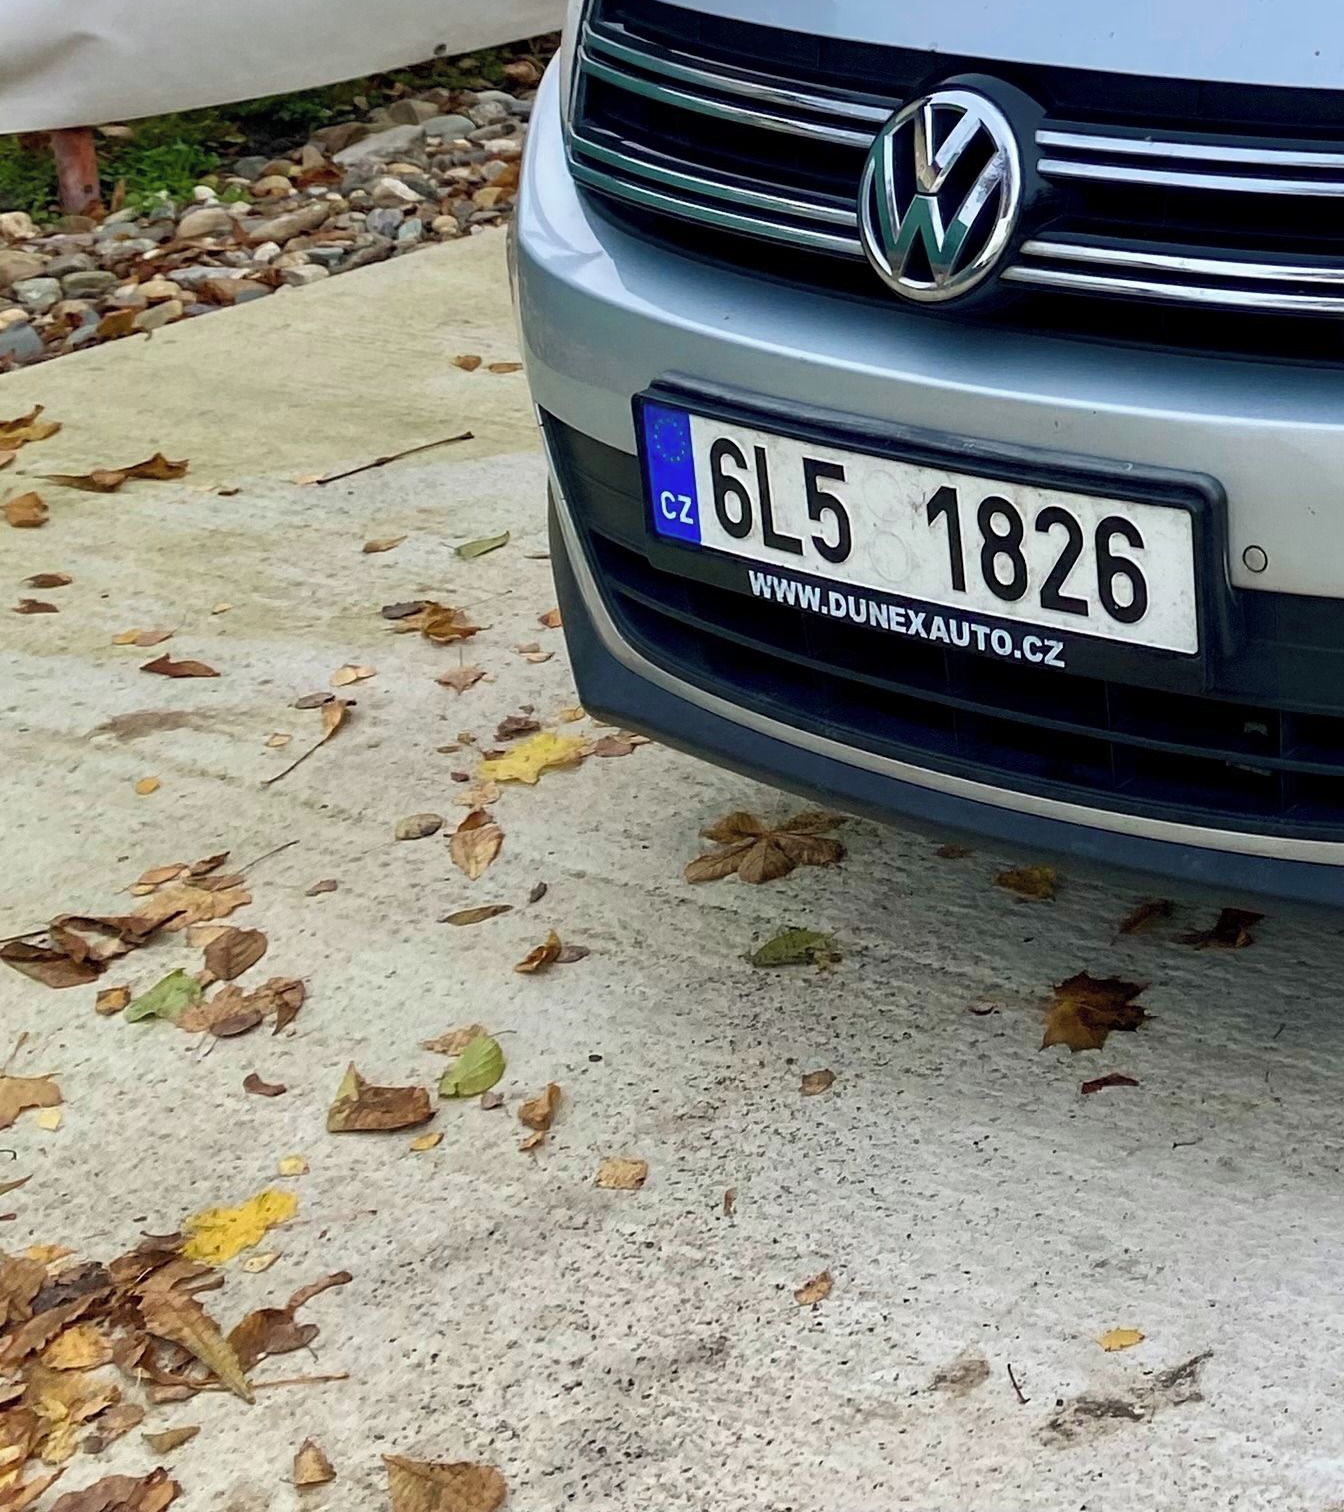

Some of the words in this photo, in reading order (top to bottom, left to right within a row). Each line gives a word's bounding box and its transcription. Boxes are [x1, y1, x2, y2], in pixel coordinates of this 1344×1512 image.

[659, 490, 695, 526] CZ
[708, 436, 853, 565] 6L5
[925, 485, 1149, 625] 1826
[748, 569, 1066, 669] WWW.DUNEXAUTO.CZ
